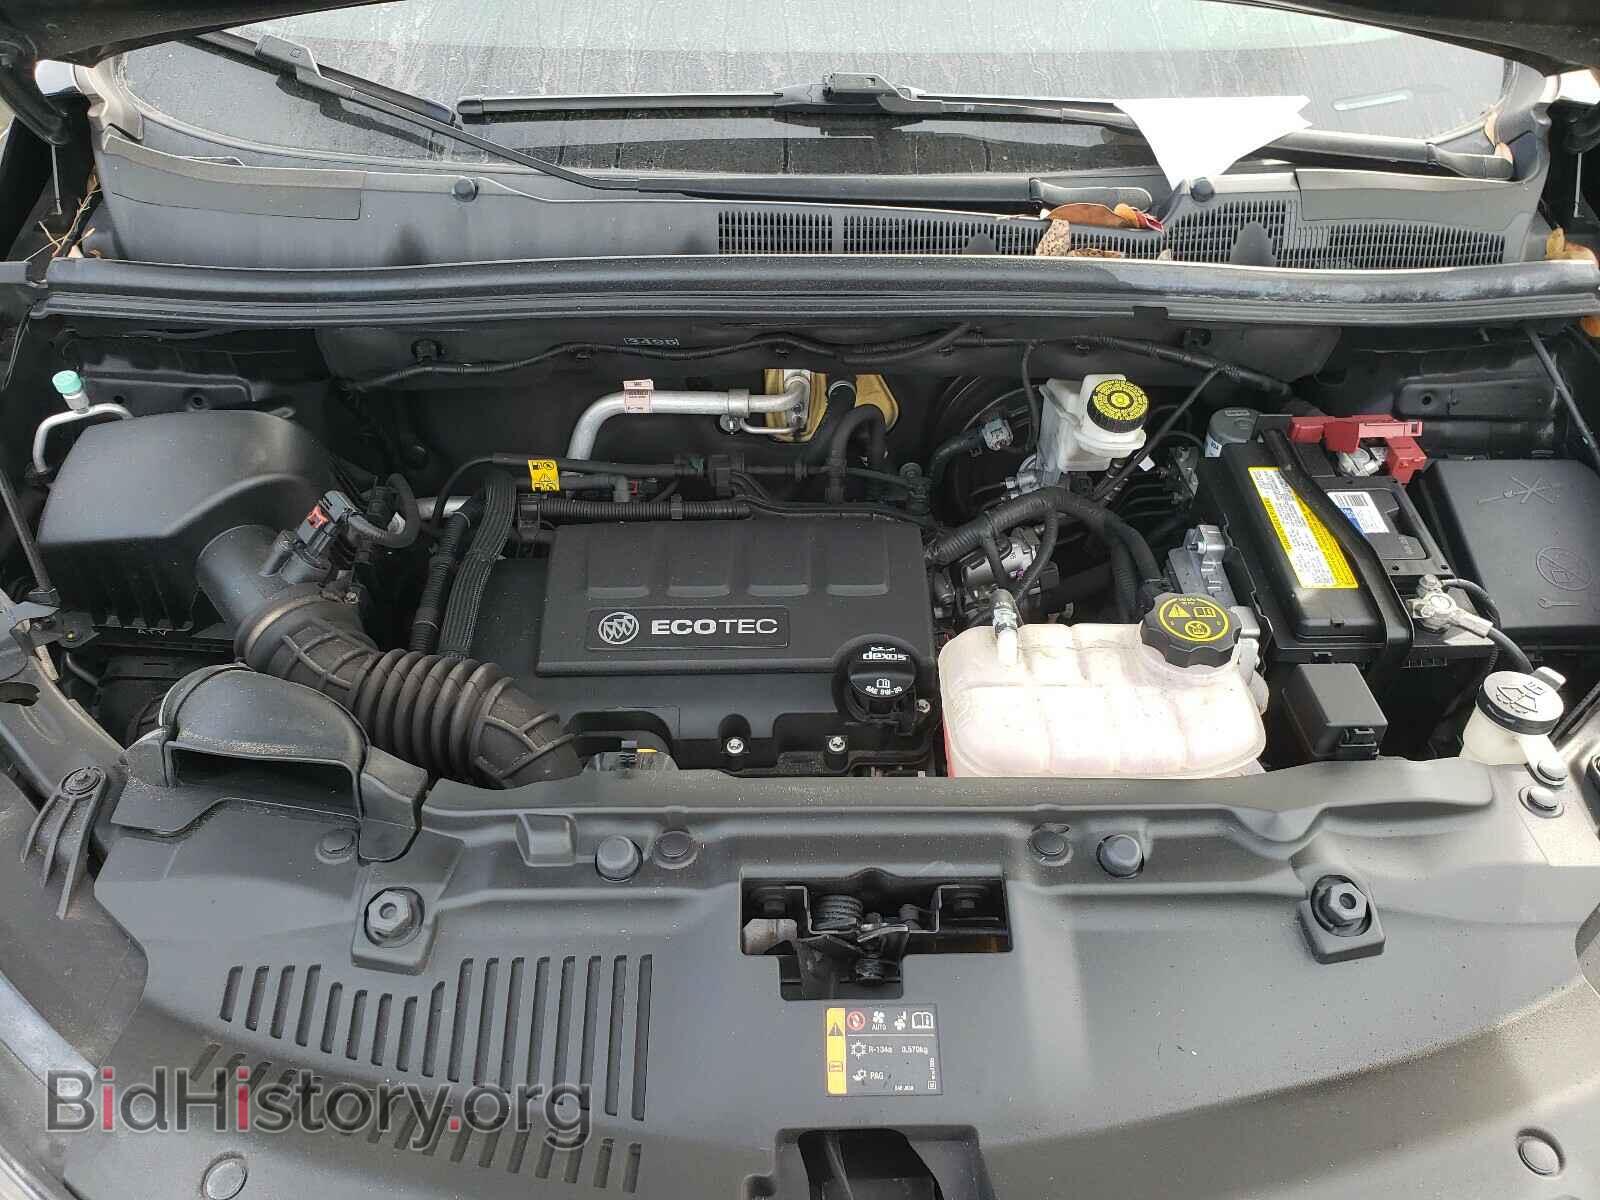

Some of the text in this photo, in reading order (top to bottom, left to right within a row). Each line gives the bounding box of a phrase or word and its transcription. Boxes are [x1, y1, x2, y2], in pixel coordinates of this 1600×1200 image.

[651, 618, 779, 635] ECOTEC
[862, 650, 909, 661] dexos
[871, 1023, 887, 1031] AUTO
[868, 1045, 893, 1054] R-134a
[870, 1071, 884, 1081] PAG
